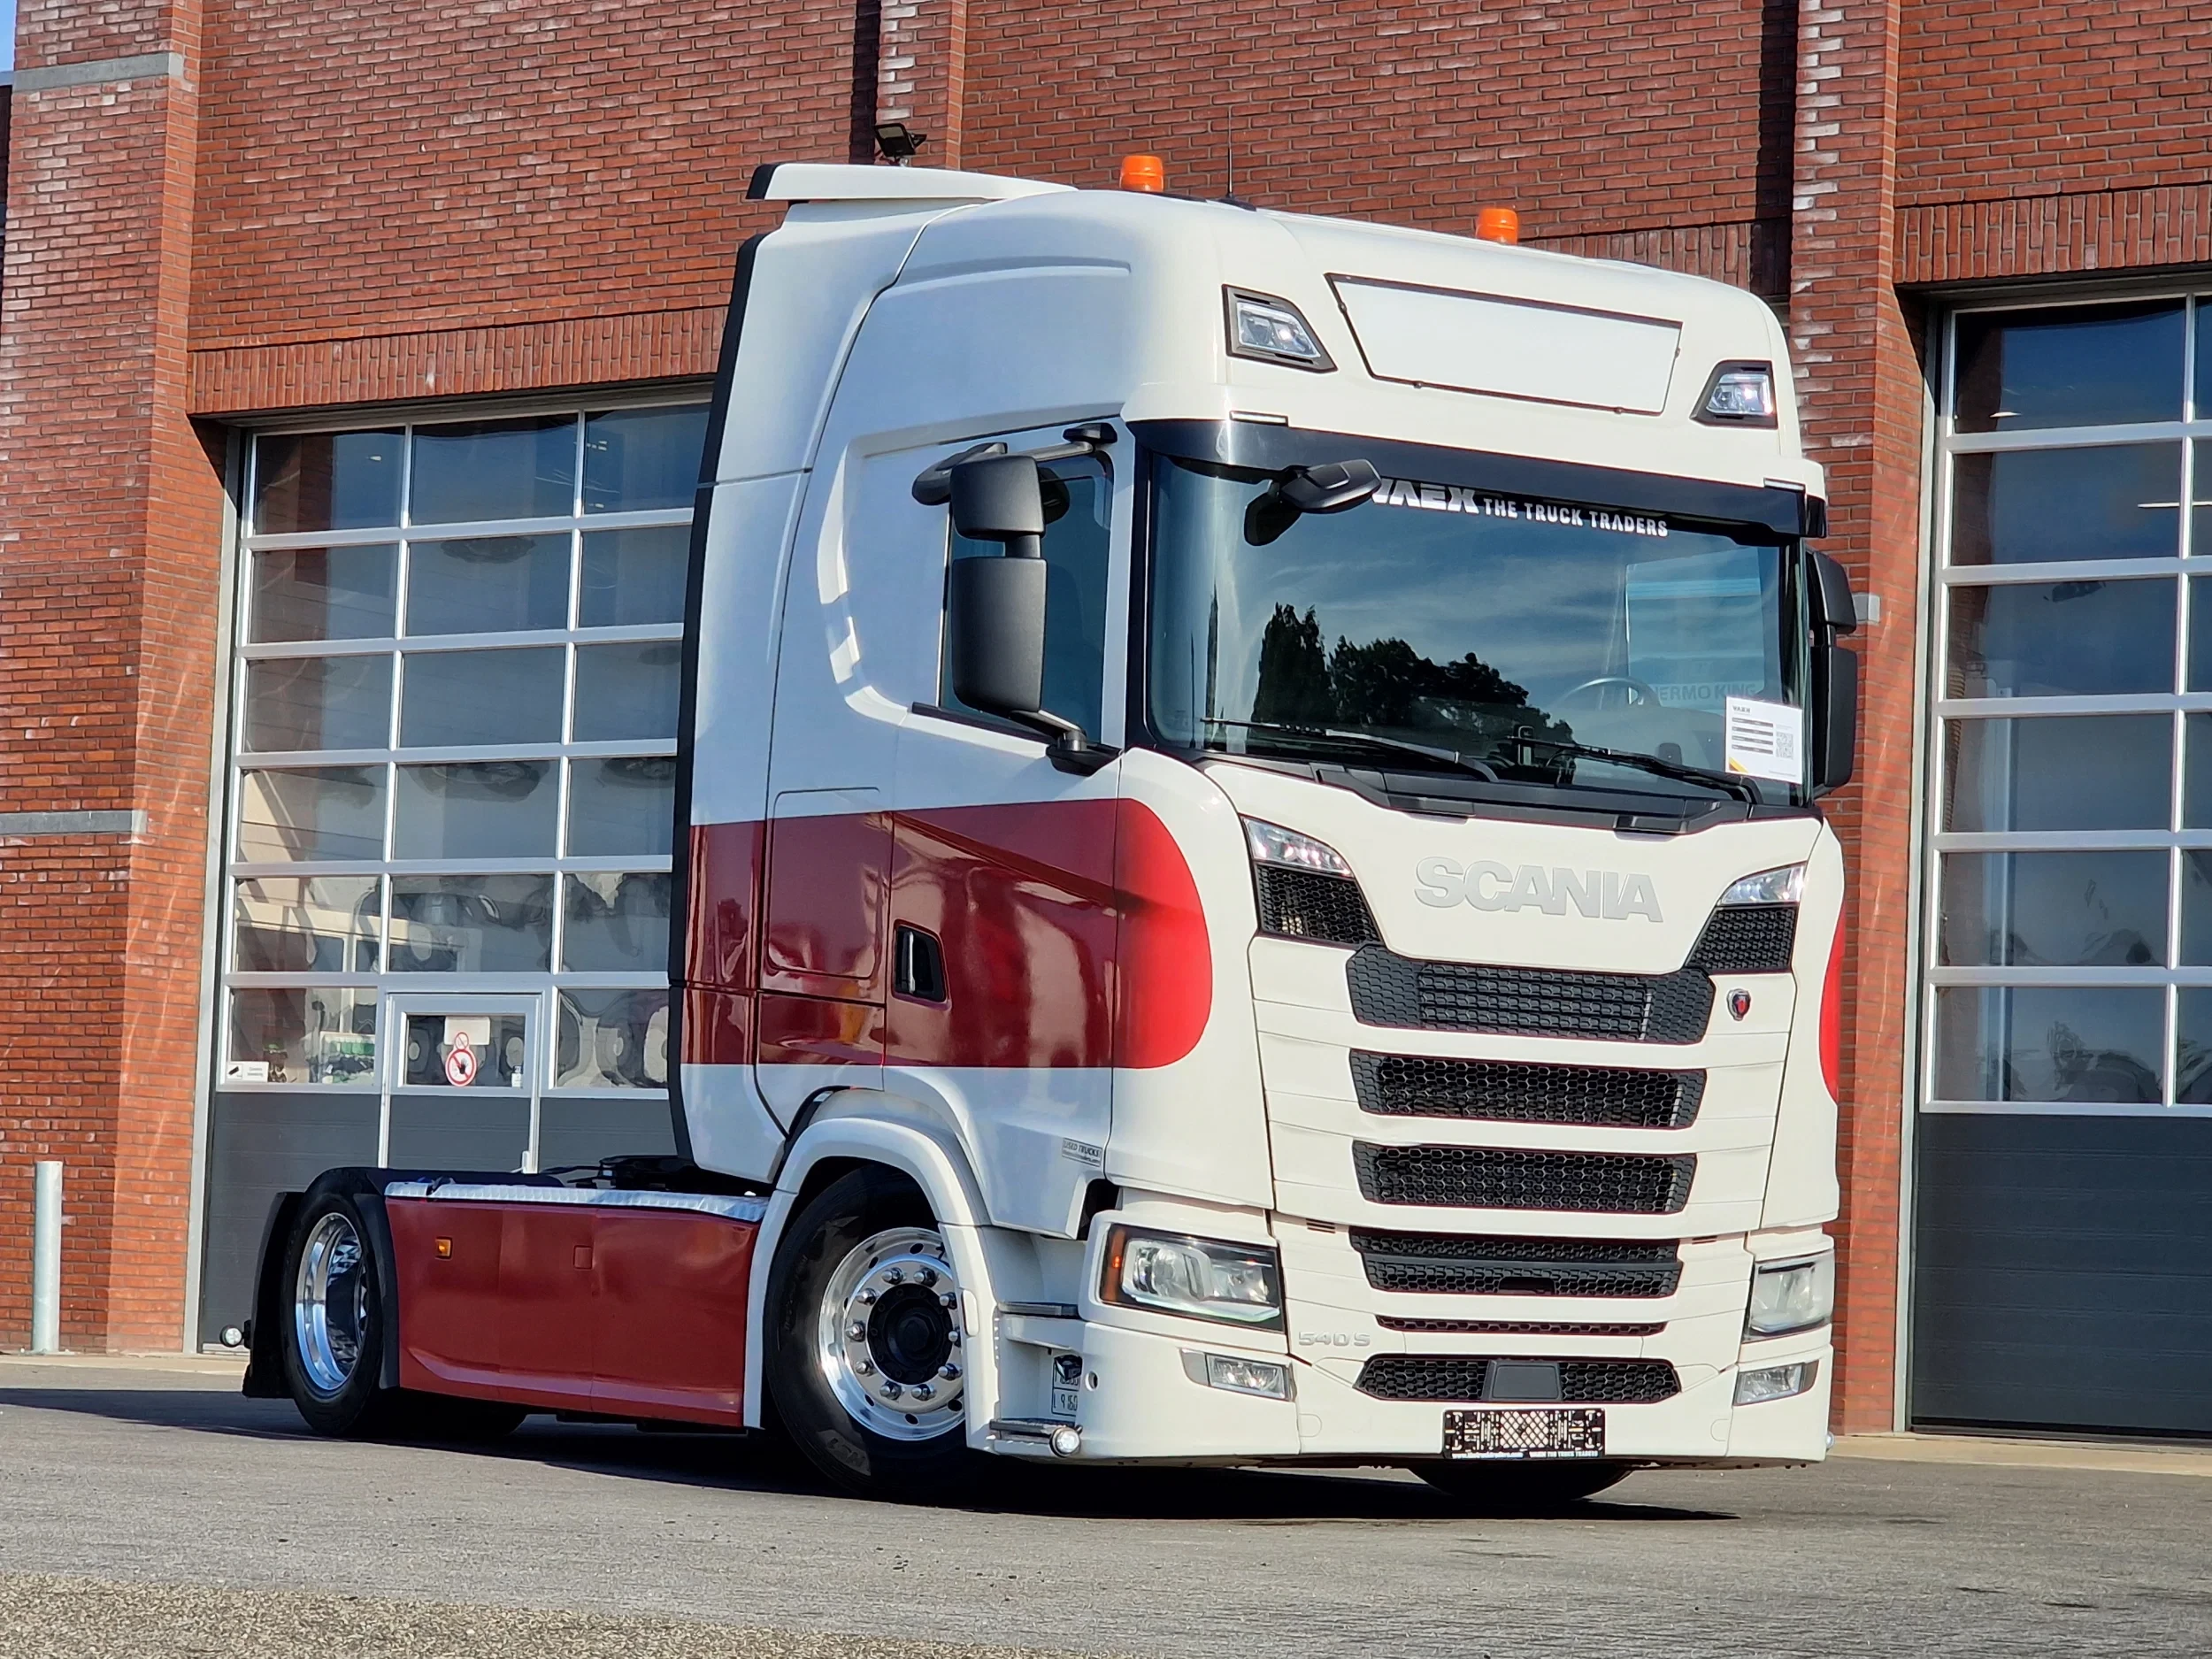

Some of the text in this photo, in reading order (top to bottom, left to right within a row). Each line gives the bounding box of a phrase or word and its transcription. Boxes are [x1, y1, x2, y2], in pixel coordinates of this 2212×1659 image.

[1483, 498, 1518, 519] THE
[1524, 503, 1584, 526] TRUCK
[1589, 511, 1669, 537] TRADERS
[1655, 685, 1711, 701] ERMO
[1415, 856, 1664, 923] SCANIA
